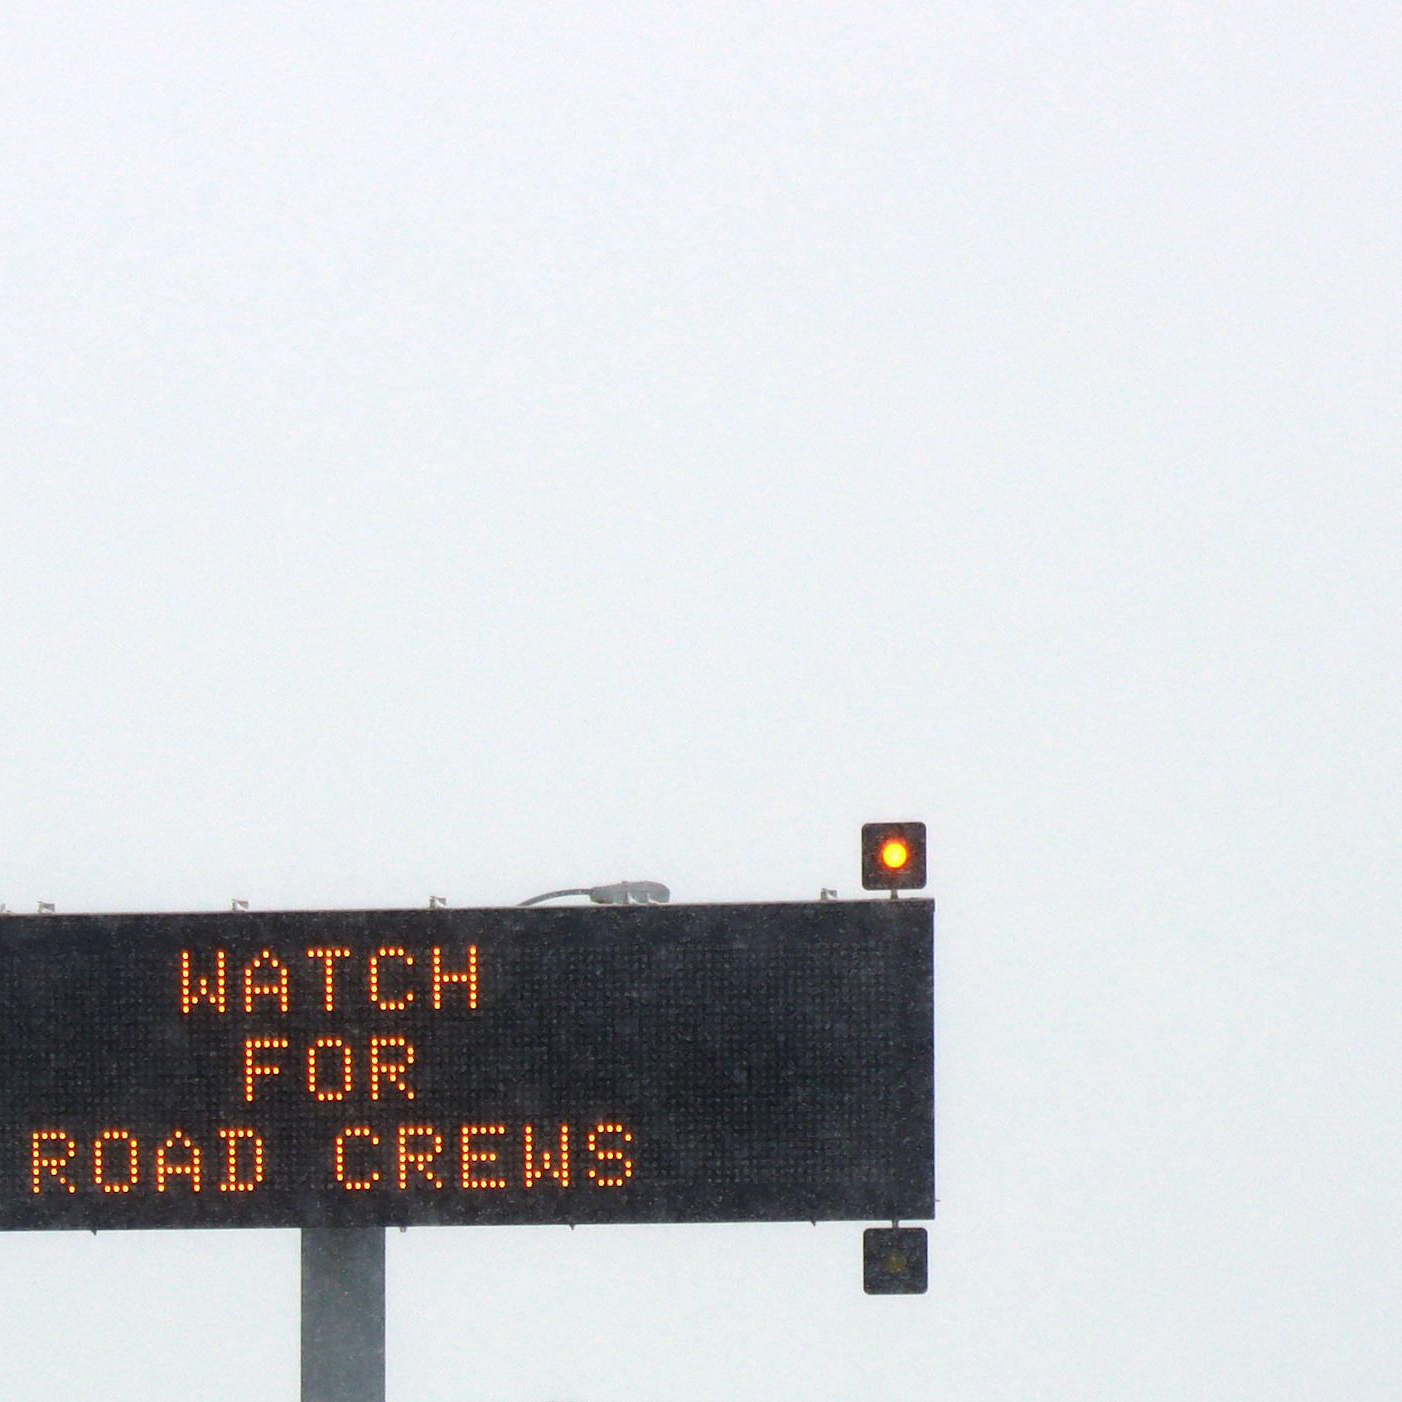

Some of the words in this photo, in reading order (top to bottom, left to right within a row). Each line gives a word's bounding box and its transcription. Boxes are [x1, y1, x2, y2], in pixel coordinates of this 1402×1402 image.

[180, 943, 479, 1014] WATCH
[243, 1035, 415, 1102] FOR
[30, 1128, 264, 1195] ROAD
[333, 1122, 633, 1193] CREWS
